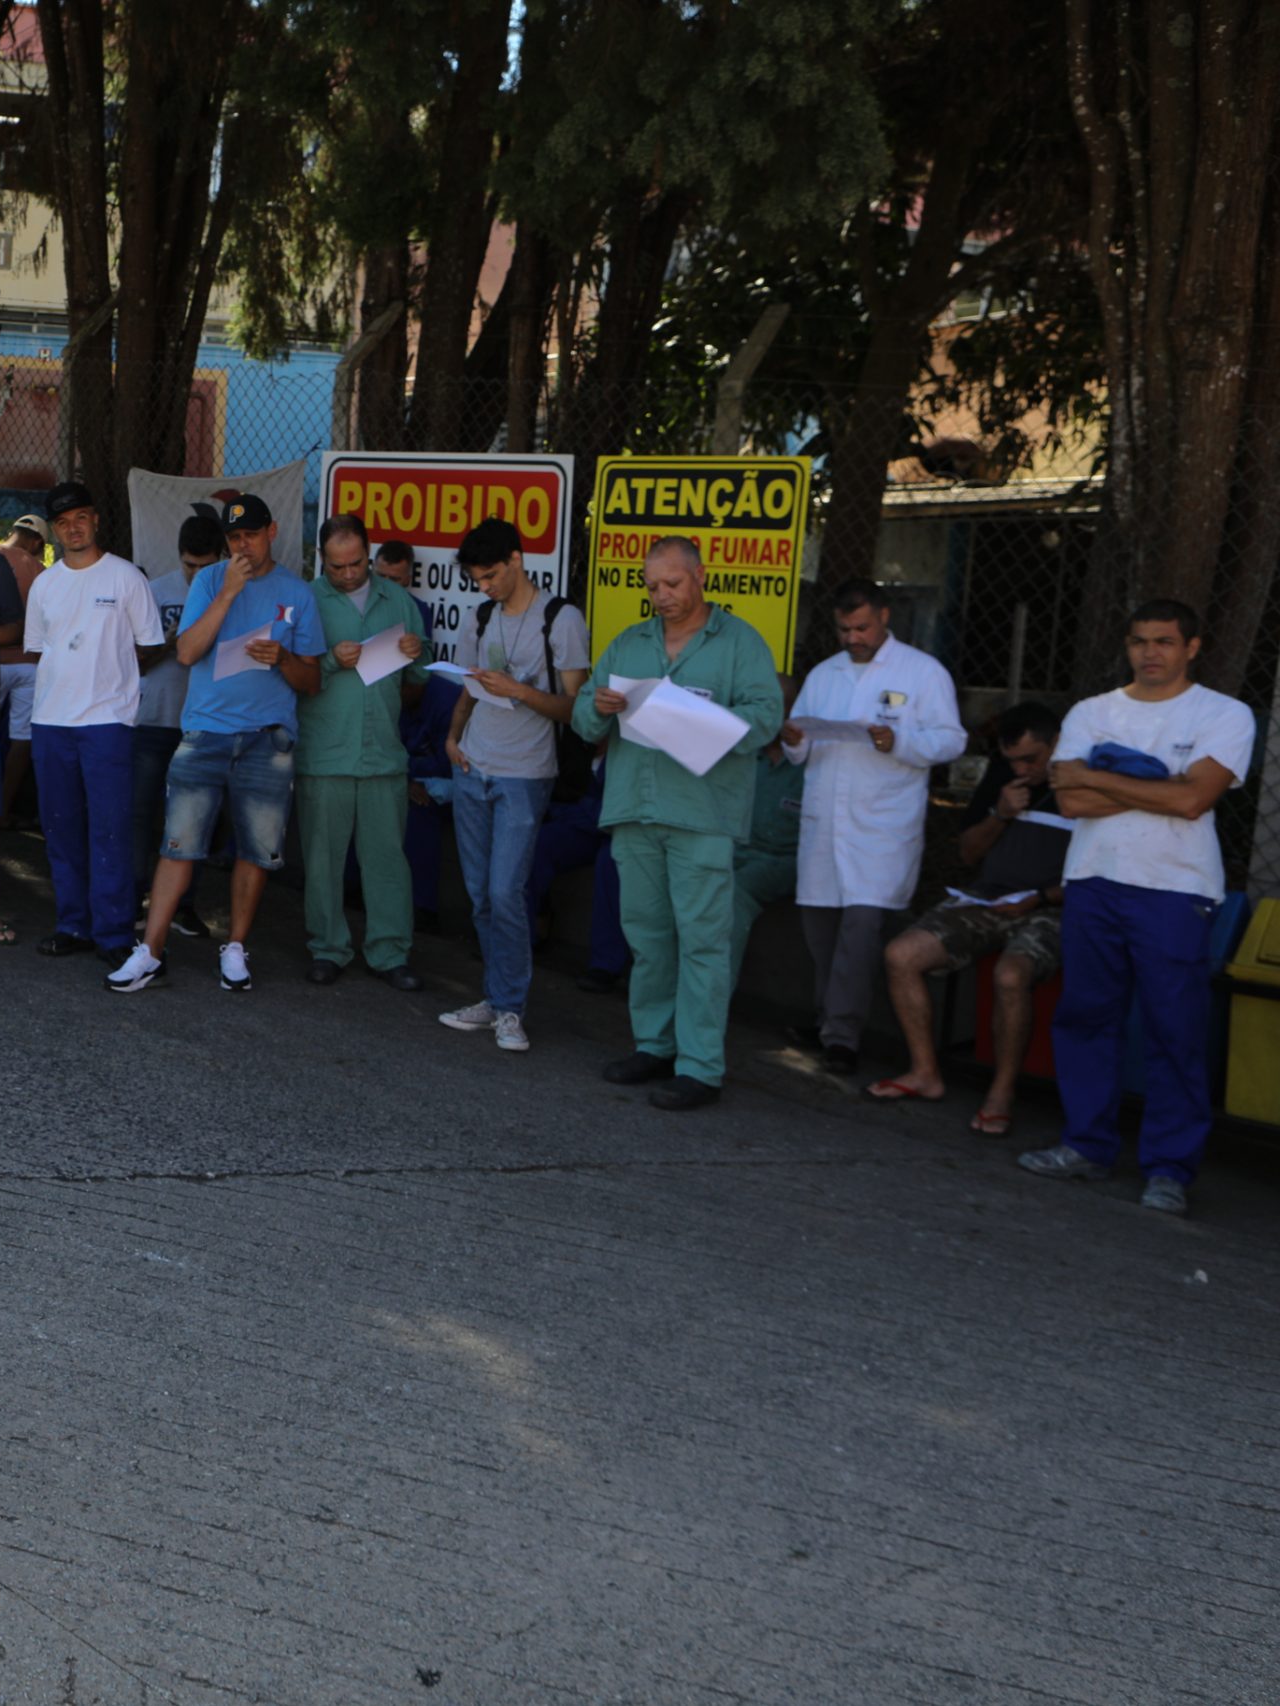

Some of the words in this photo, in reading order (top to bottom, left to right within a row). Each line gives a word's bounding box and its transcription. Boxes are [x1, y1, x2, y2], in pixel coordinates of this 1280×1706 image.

[338, 480, 551, 540] PROIBIDO
[605, 470, 794, 527] ATENÇÃO
[709, 536, 792, 566] FUMAR
[428, 563, 454, 591] OU
[598, 567, 620, 587] NO
[626, 569, 787, 597] ESNAMENTO
